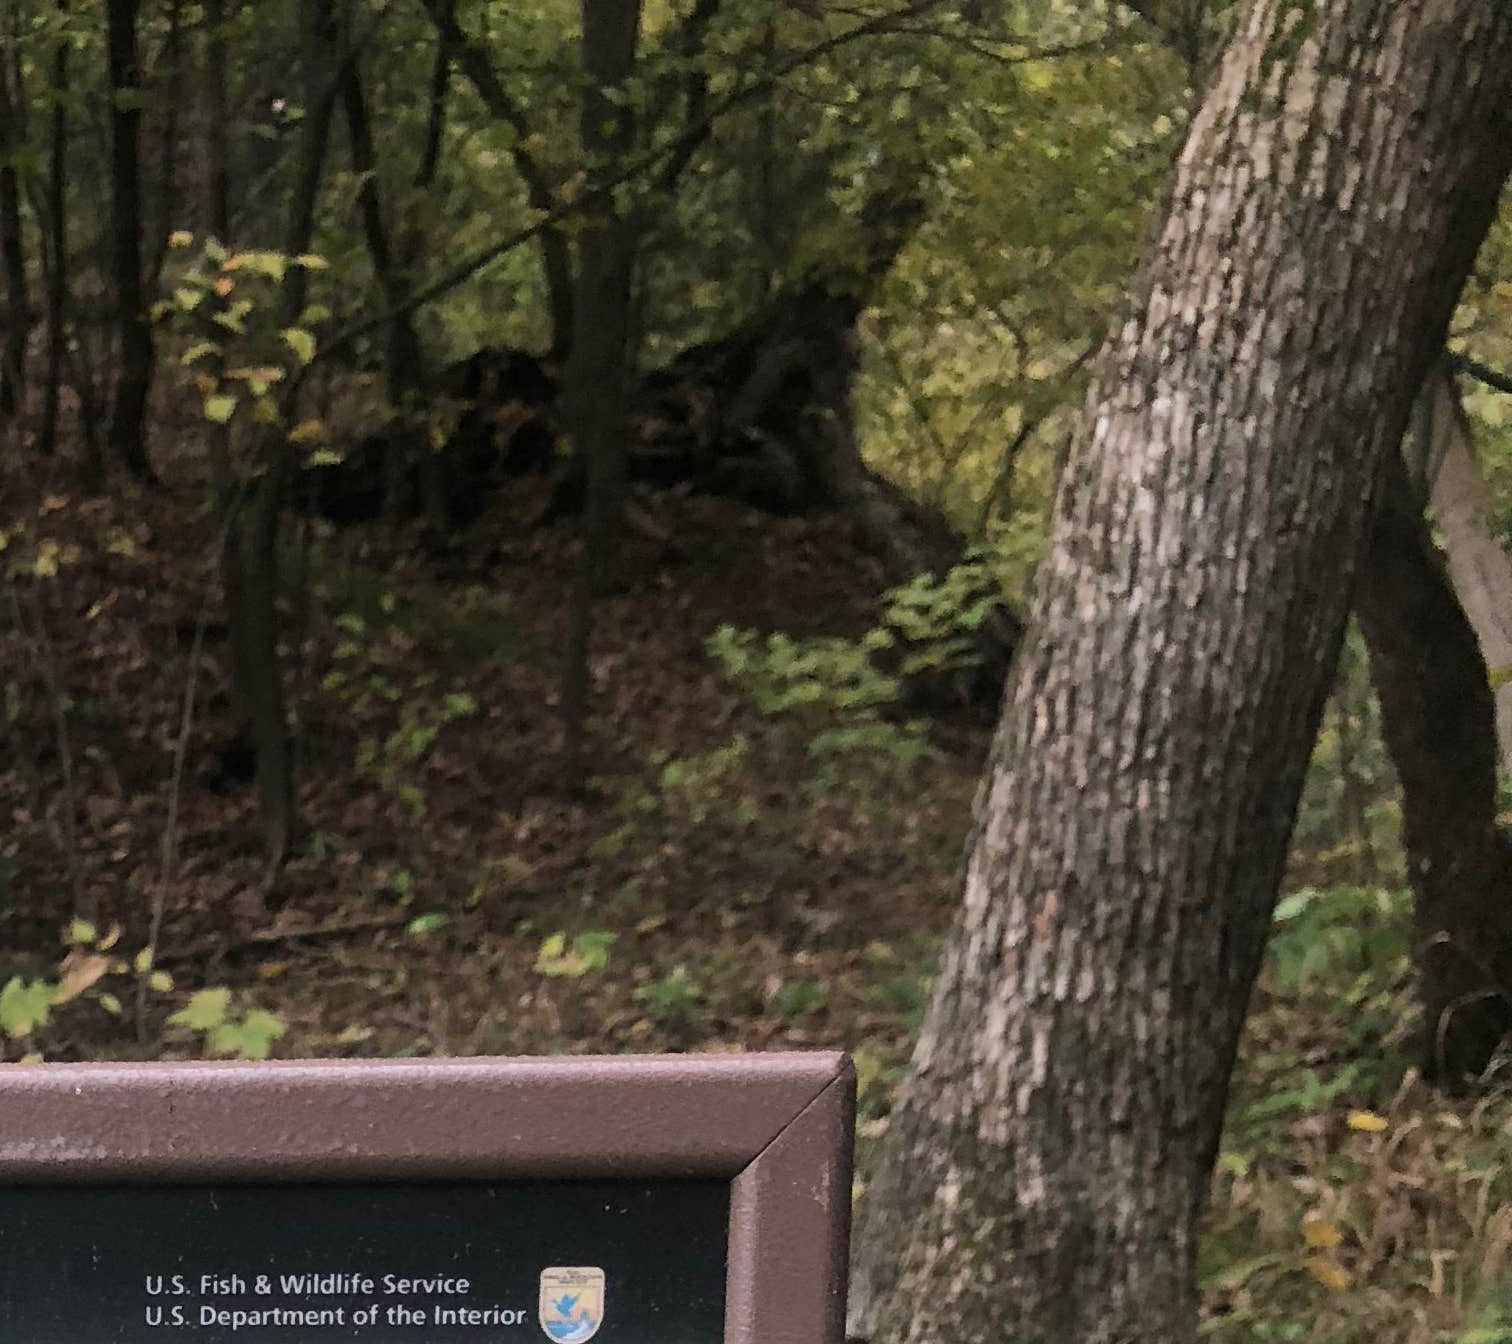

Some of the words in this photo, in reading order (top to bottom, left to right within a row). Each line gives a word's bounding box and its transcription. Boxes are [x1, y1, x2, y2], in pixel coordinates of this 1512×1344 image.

[147, 1275, 190, 1294] U.S.
[201, 1274, 245, 1294] Fish
[255, 1275, 271, 1294] &
[280, 1273, 374, 1294] Wildlife
[384, 1273, 469, 1294] Service
[146, 1306, 189, 1325] U.S.
[201, 1306, 344, 1330] Department
[353, 1304, 378, 1326] of
[387, 1304, 426, 1325] the
[435, 1305, 526, 1325] Interior
